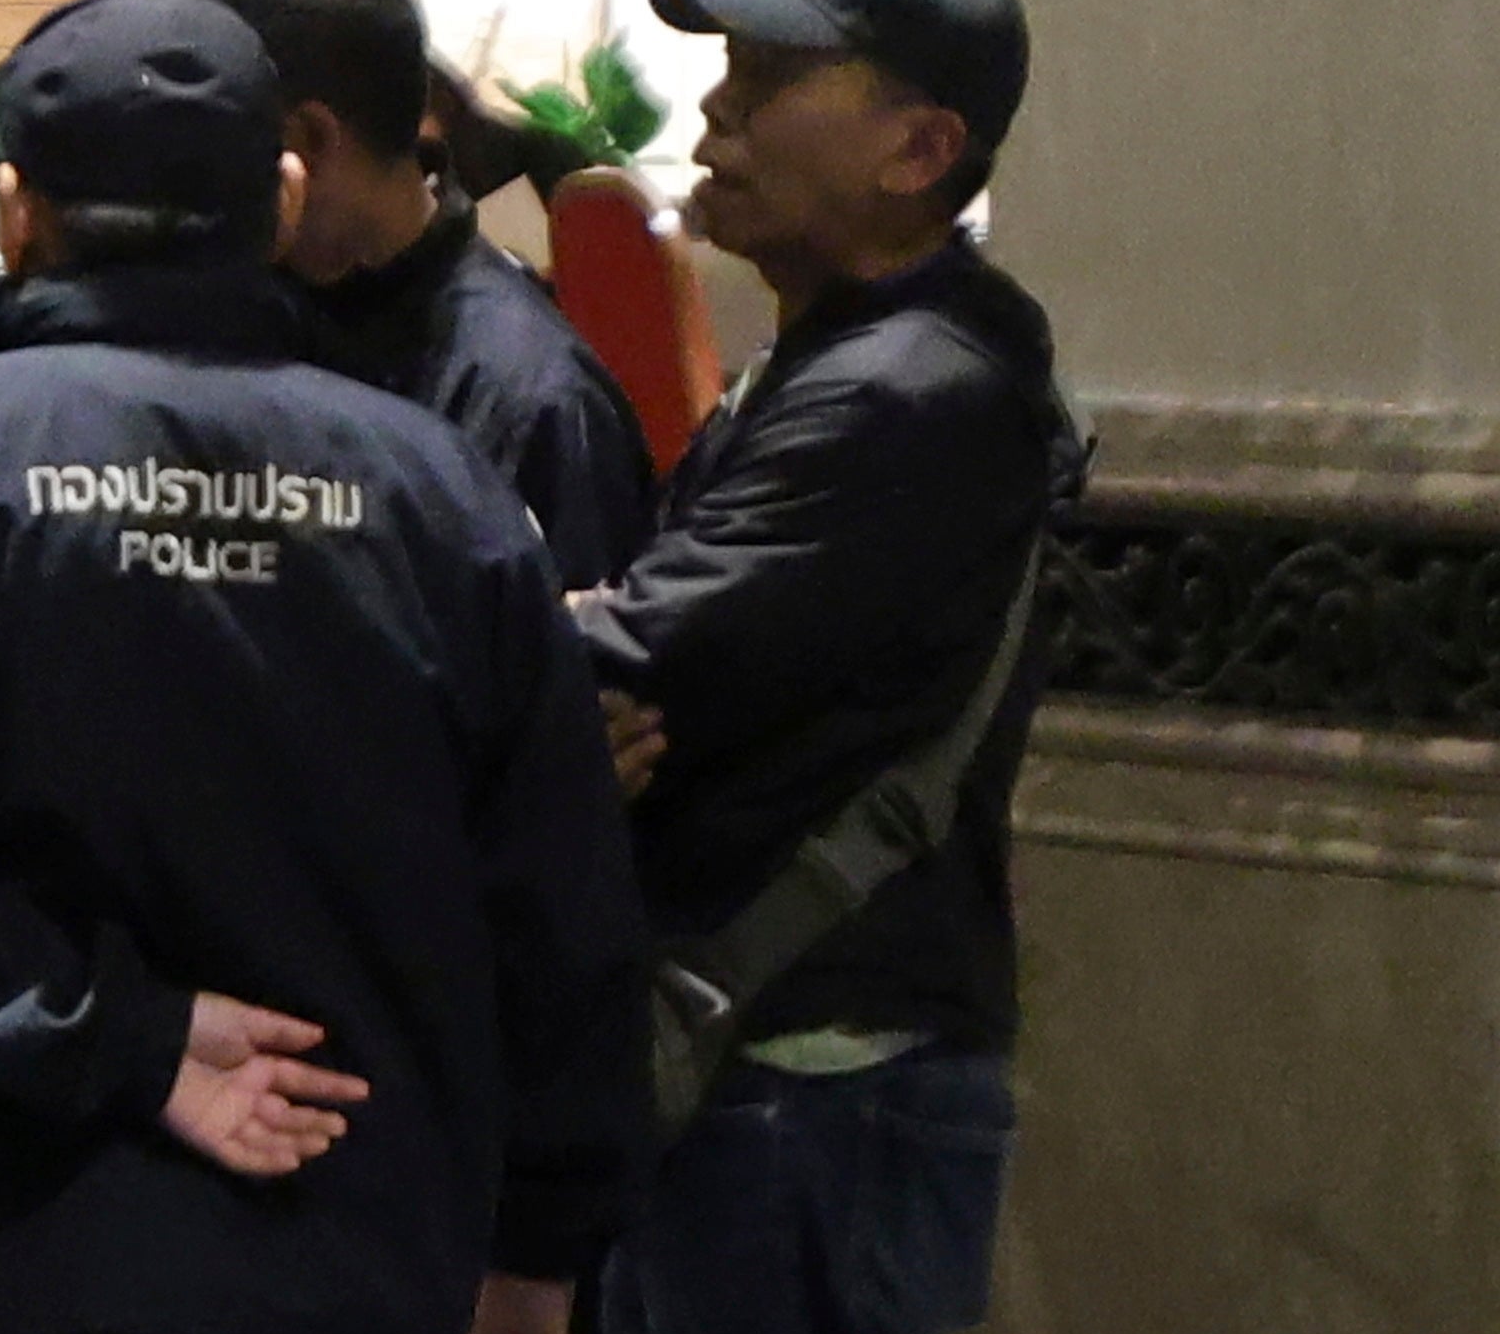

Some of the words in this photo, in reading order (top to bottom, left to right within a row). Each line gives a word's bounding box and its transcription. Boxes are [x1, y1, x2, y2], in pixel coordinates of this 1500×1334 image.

[26, 456, 362, 527] กองปราบปราม
[119, 529, 280, 584] POLICE
